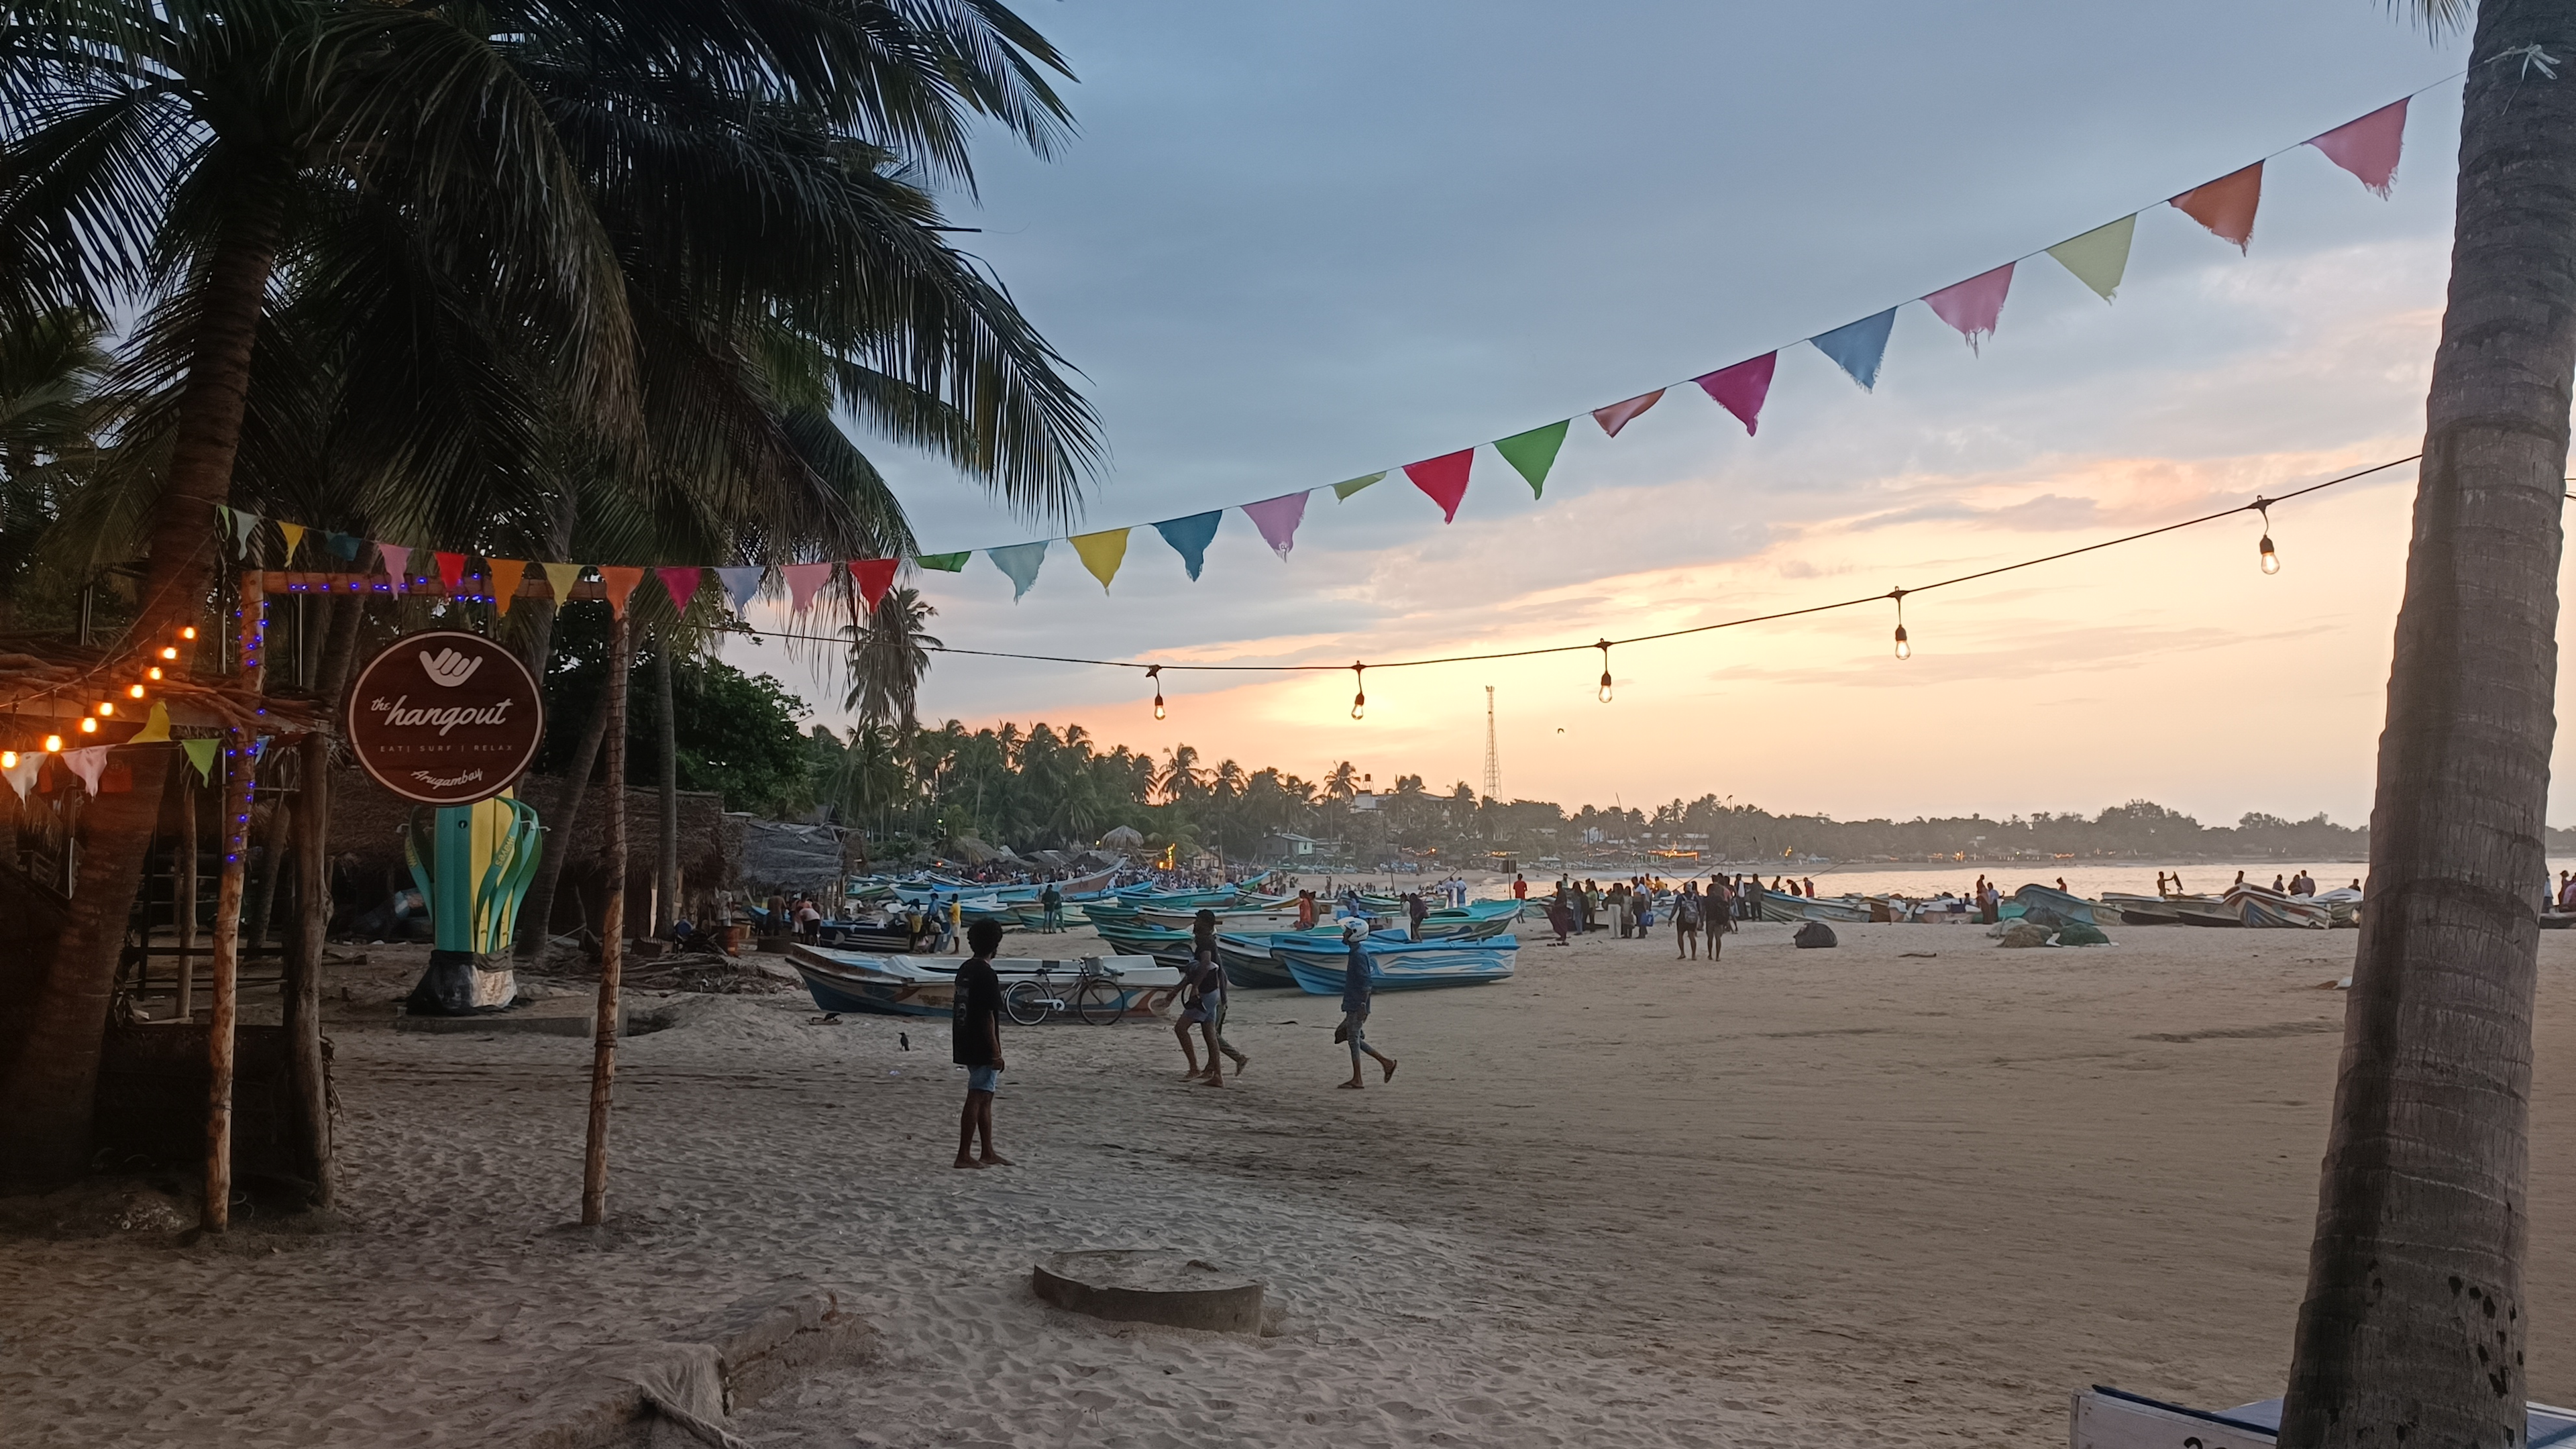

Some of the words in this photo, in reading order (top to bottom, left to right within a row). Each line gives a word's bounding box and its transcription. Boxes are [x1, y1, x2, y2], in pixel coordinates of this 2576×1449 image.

[371, 696, 392, 711] the
[384, 695, 514, 737] hangout
[411, 767, 483, 790] Arugambay
